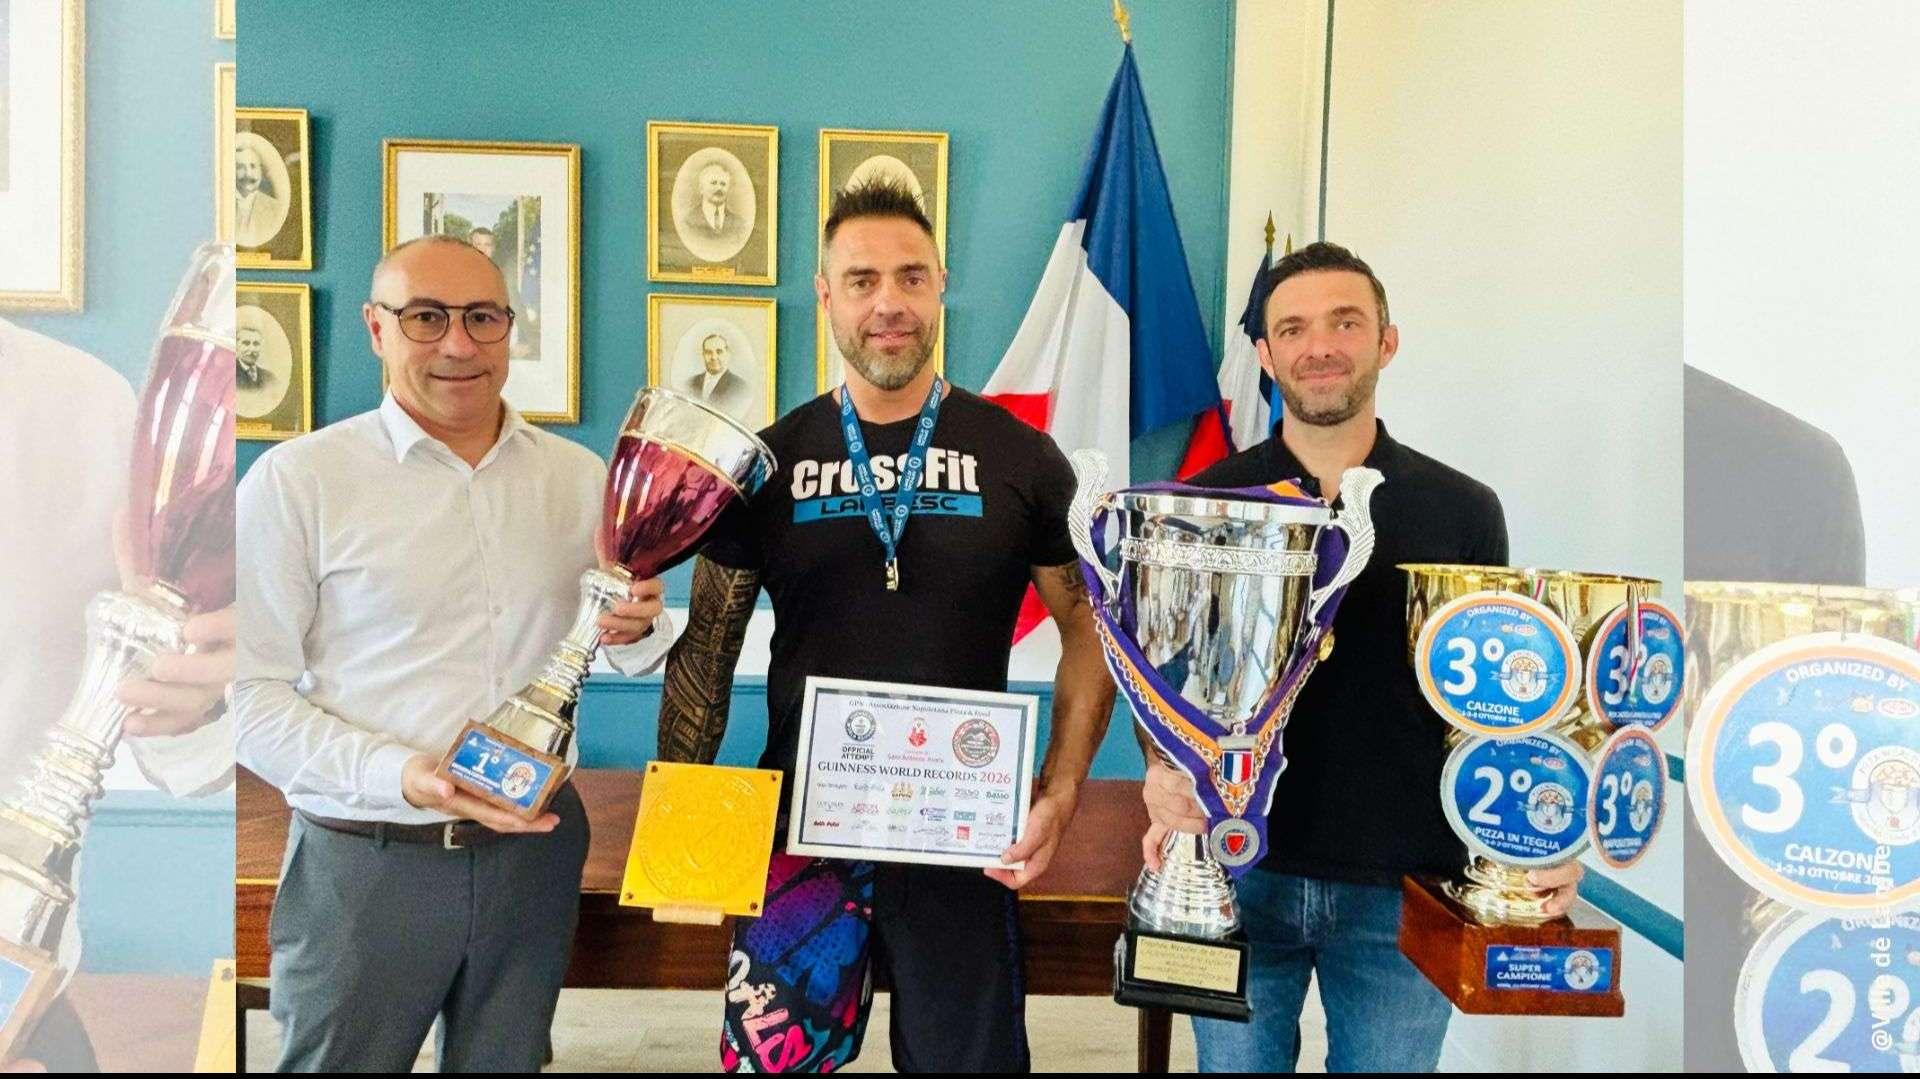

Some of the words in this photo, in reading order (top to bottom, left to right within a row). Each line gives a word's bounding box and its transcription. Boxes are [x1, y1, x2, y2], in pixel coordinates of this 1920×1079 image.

[820, 497, 960, 515] LABESC
[1466, 605, 1518, 617] ORGANIZED
[1786, 661, 1885, 682] ORGANIZED
[1466, 701, 1520, 716] CALZONE
[818, 761, 876, 775] GUINNESS
[879, 765, 921, 778] WORLD
[924, 768, 977, 782] RECORDS
[979, 771, 1012, 785] 2026
[1475, 827, 1504, 840] PIZZA
[1507, 832, 1520, 844] IN
[1522, 835, 1560, 851] TEGLIA
[1509, 963, 1541, 972] SUPER
[1497, 972, 1552, 981] CAMPIONE
